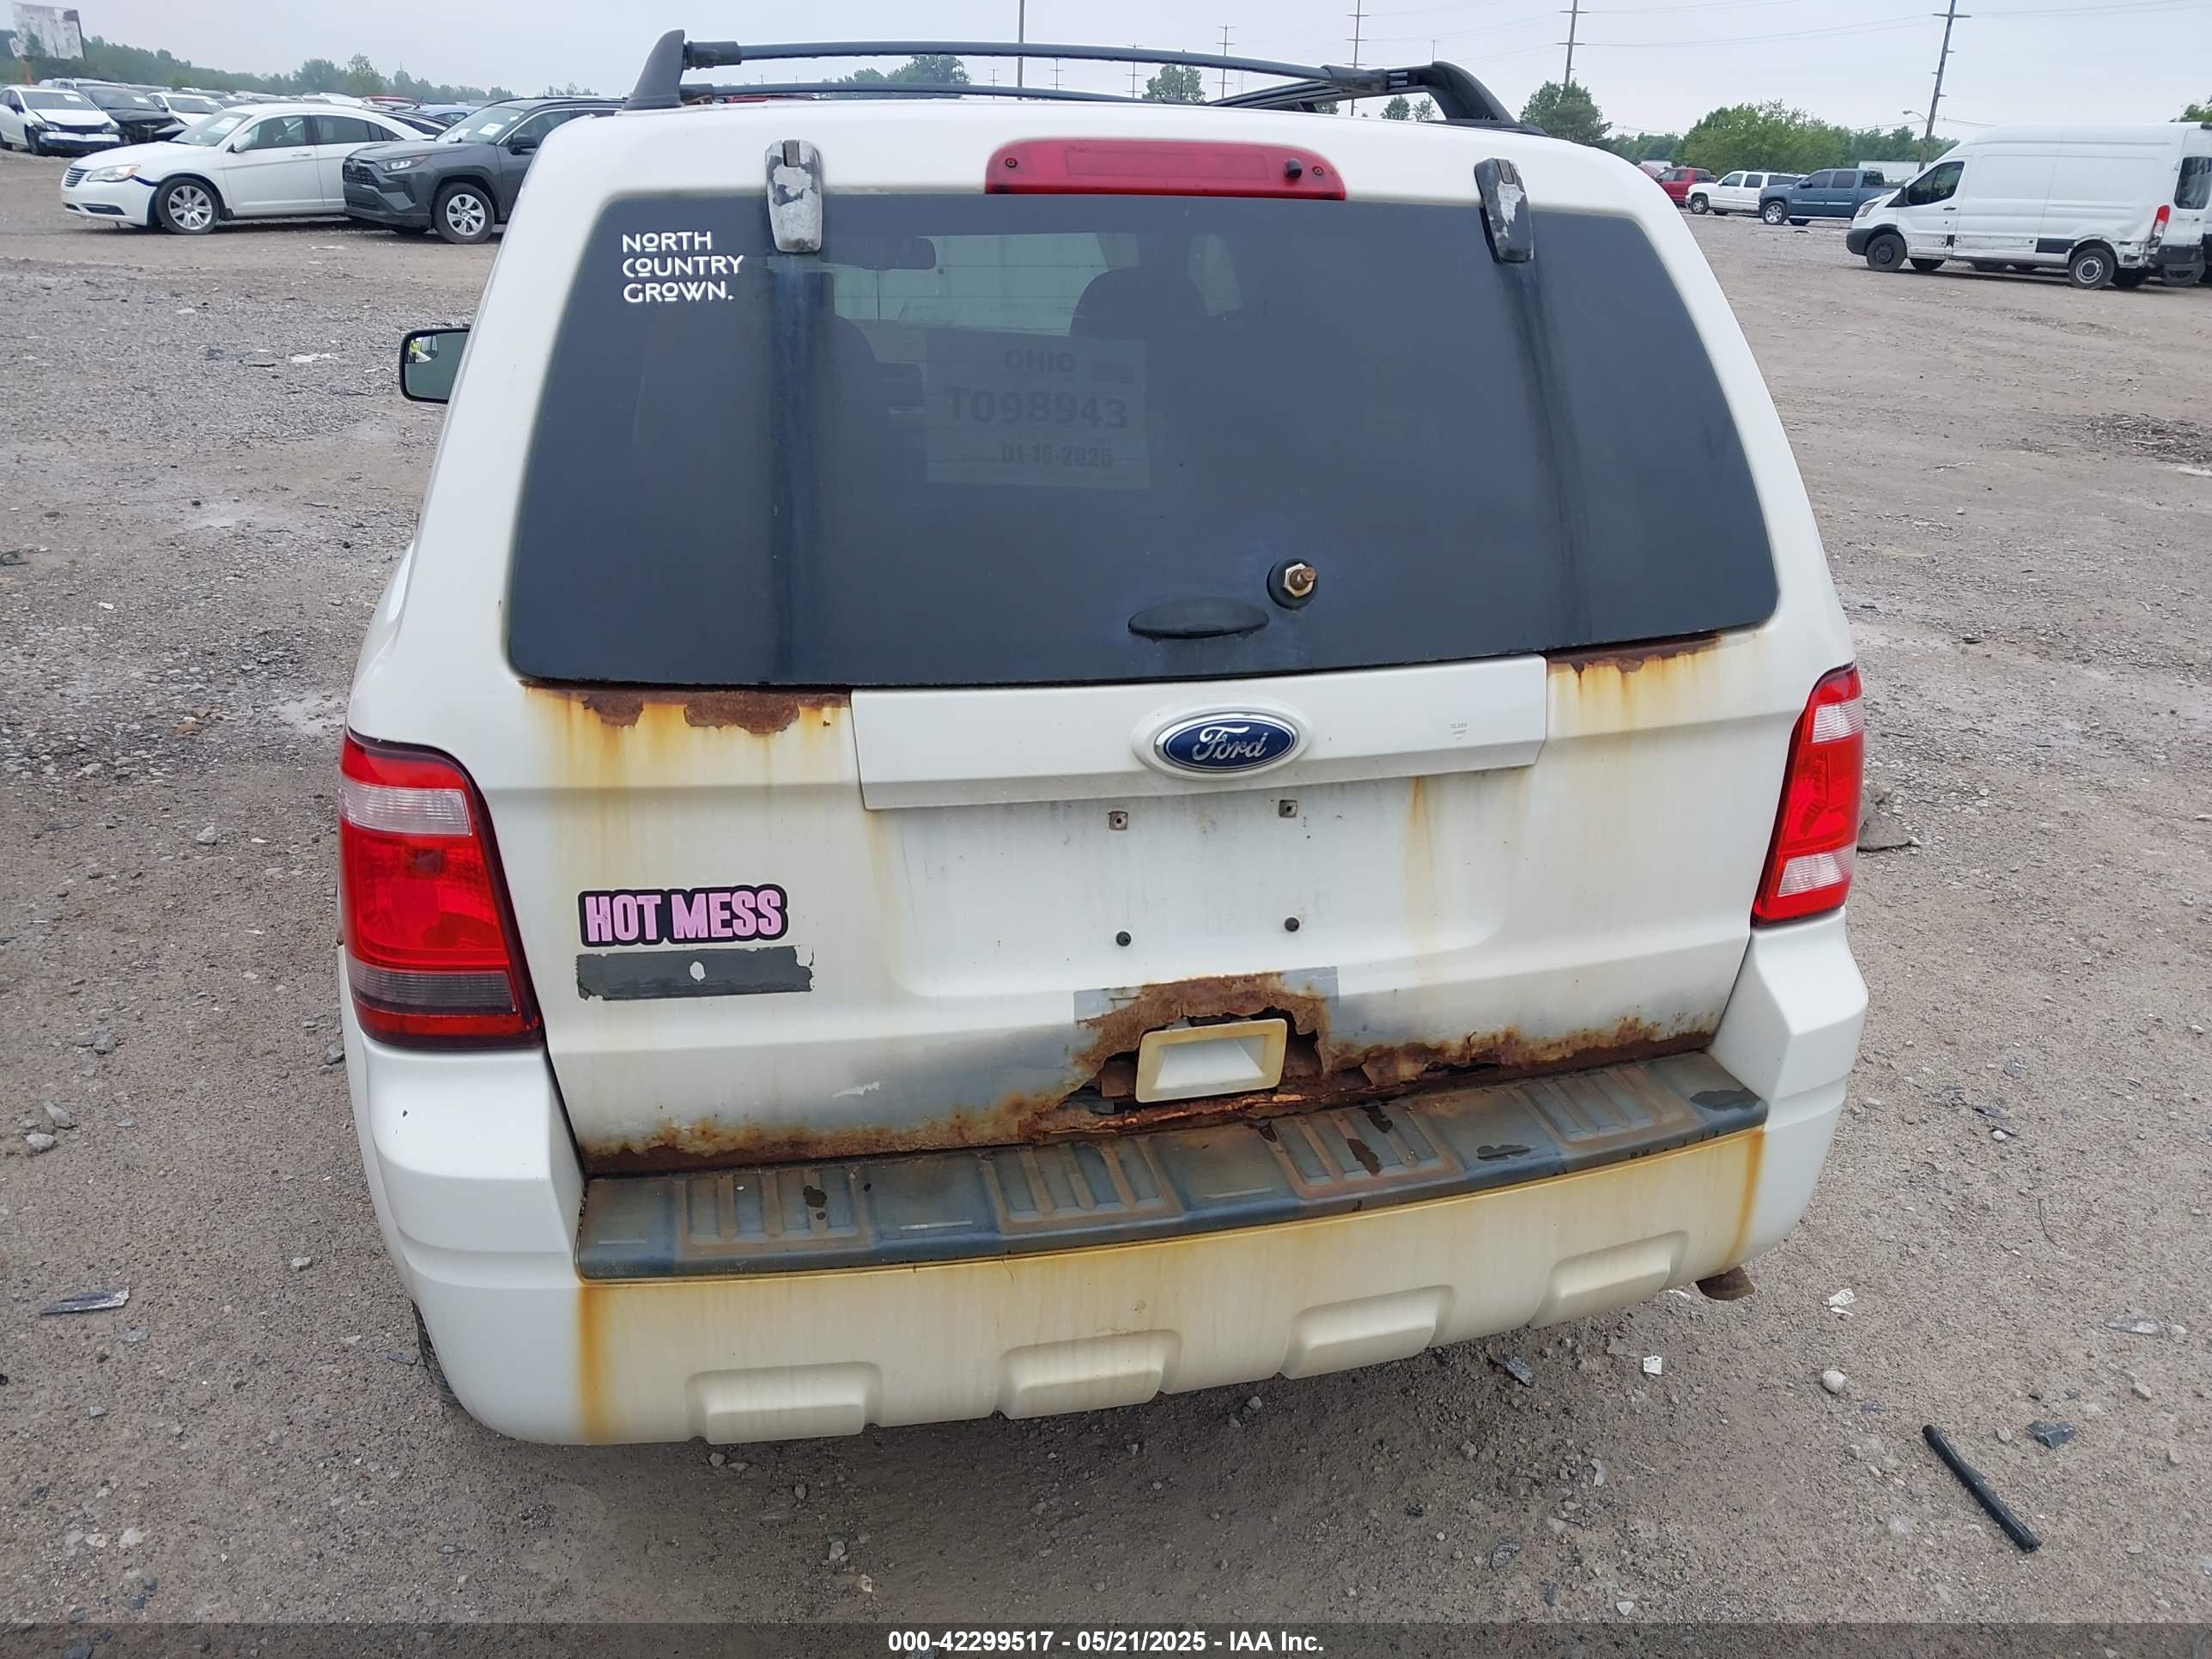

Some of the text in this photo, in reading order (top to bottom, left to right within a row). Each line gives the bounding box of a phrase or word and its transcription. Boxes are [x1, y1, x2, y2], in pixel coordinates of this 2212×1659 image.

[622, 230, 712, 252] NORTH
[622, 254, 744, 278] COUNTRY
[623, 280, 734, 303] GROWN.
[1004, 349, 1077, 373] OHIO
[1191, 726, 1269, 761] Ford
[584, 889, 782, 942] HOT MESS
